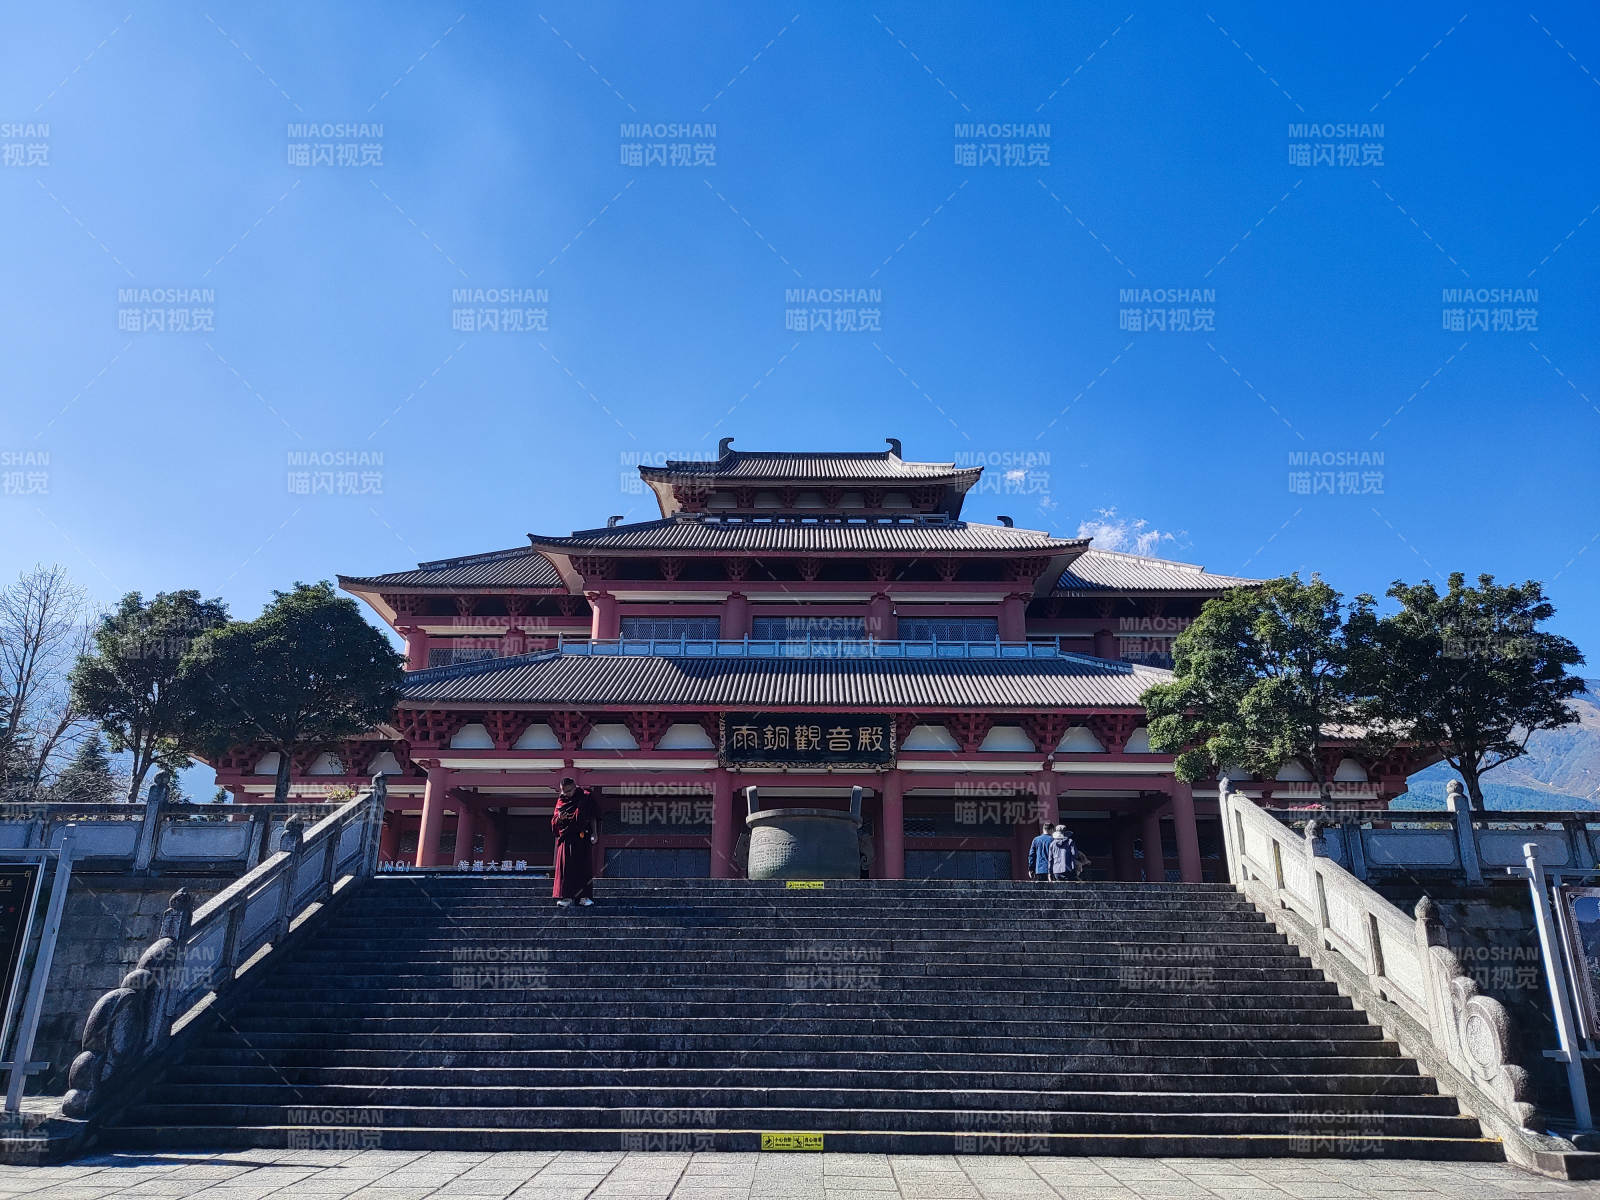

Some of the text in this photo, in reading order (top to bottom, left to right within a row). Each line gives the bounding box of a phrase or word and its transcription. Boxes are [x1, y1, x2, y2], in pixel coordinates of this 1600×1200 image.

[731, 724, 885, 752] 雨銅觀音殿
